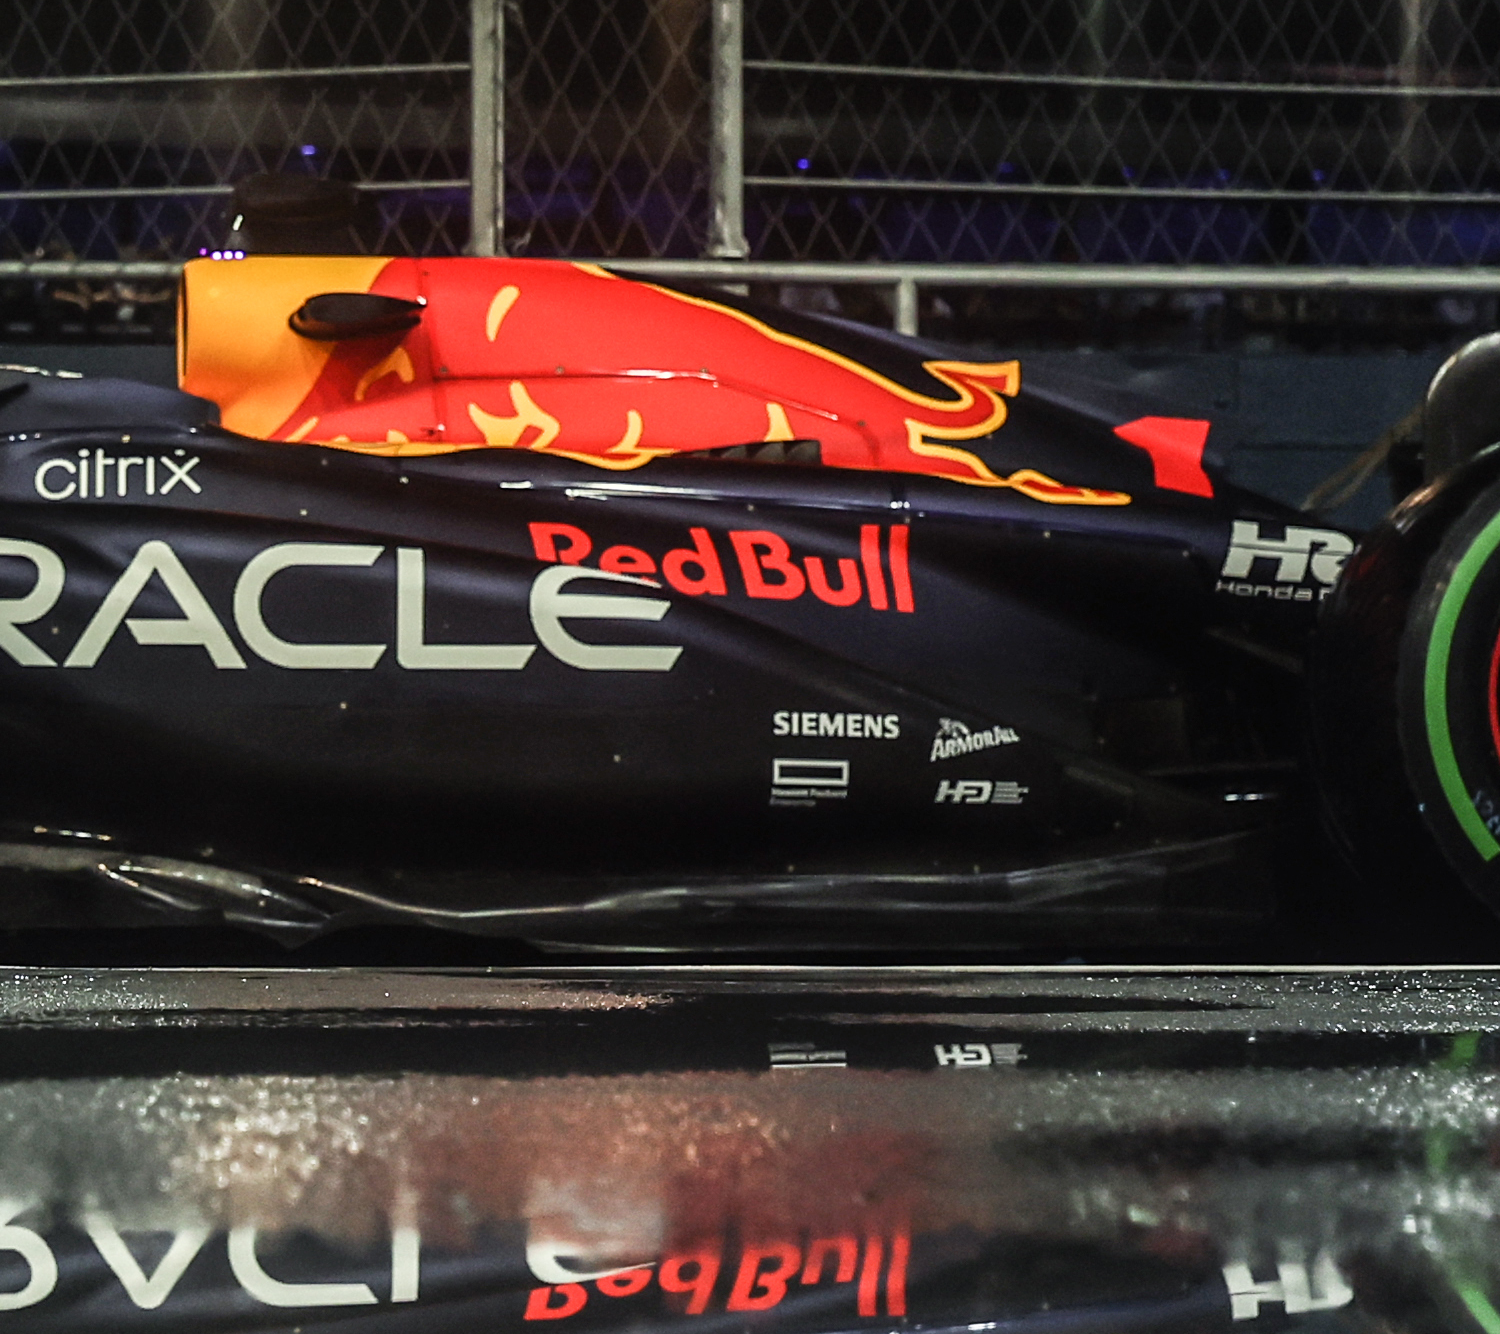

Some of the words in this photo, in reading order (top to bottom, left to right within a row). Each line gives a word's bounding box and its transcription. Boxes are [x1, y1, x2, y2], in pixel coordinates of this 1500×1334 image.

[34, 448, 201, 500] citrix
[529, 521, 725, 597] Red
[729, 524, 914, 613] Bull
[1215, 579, 1313, 602] Honda
[773, 710, 900, 740] SIEMENS
